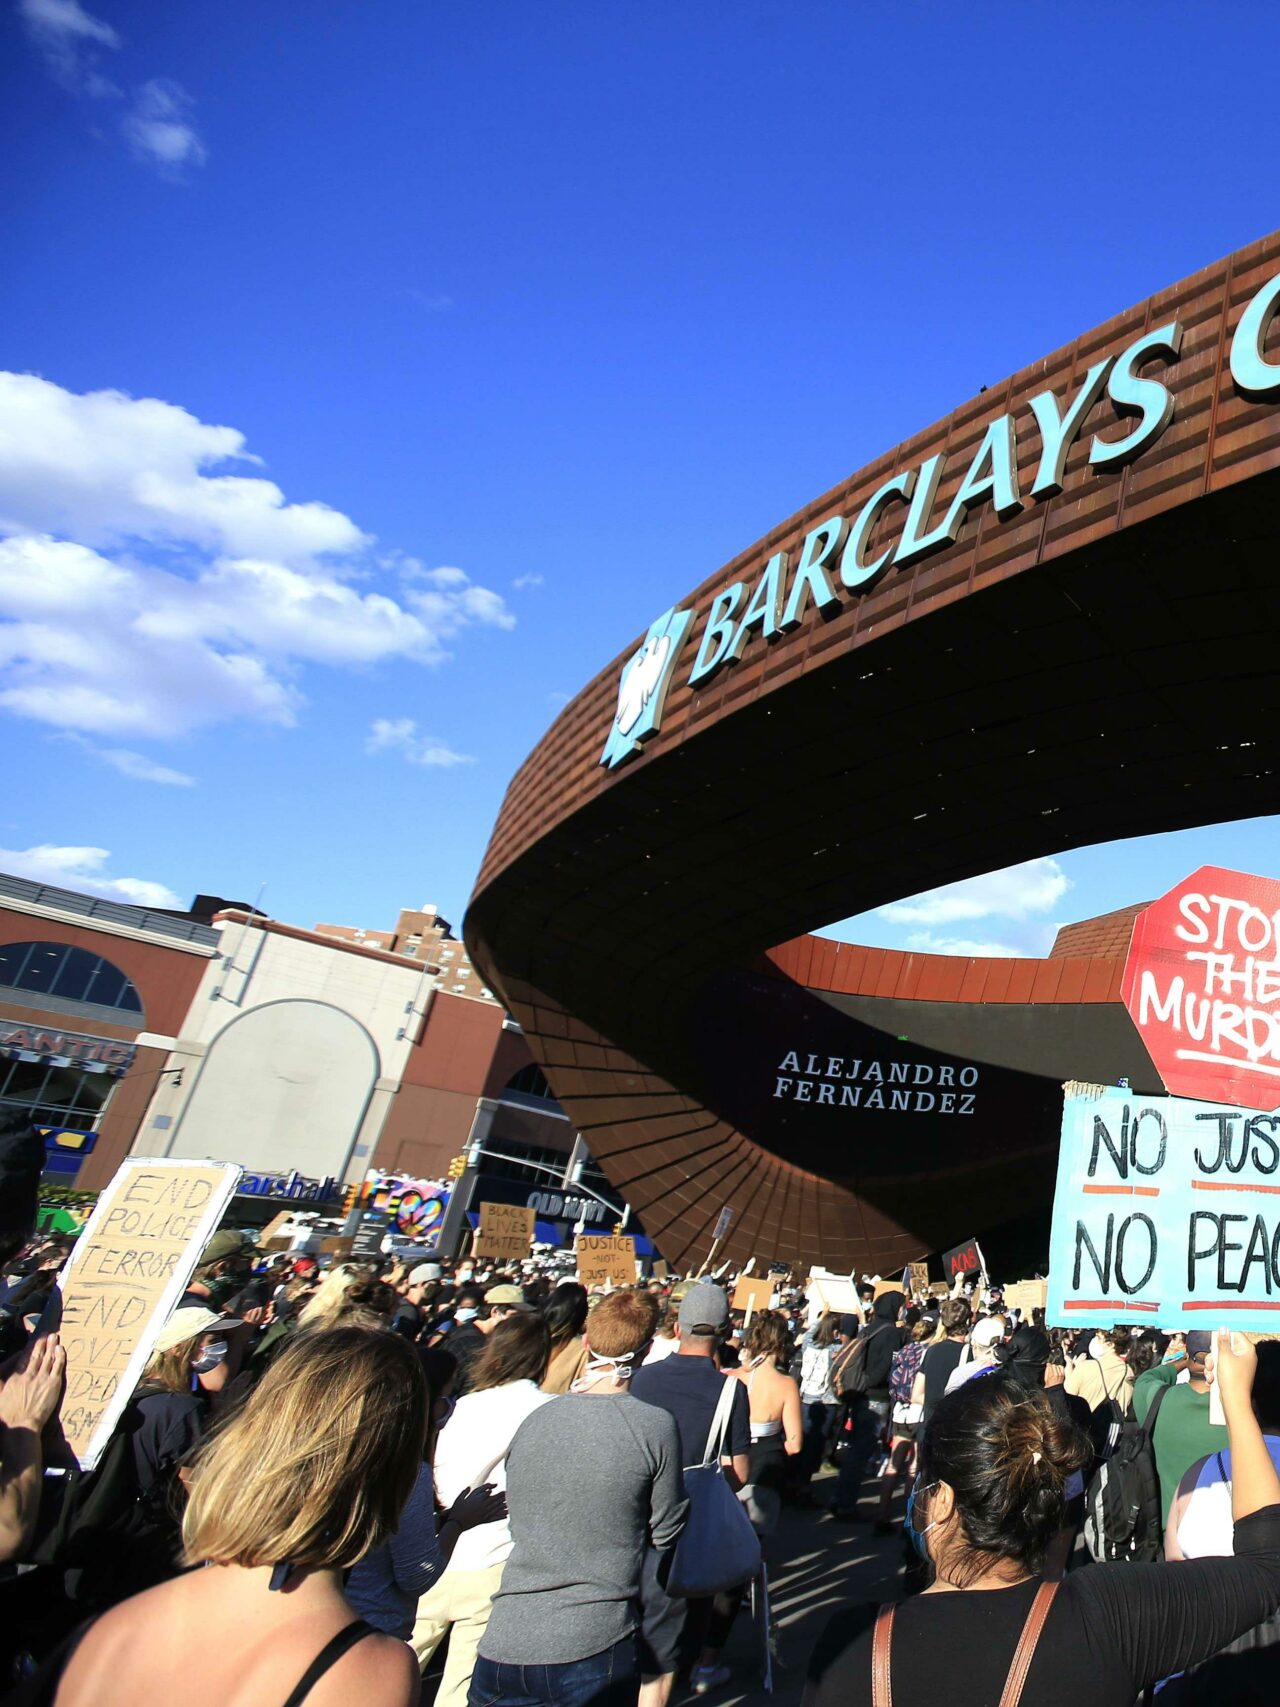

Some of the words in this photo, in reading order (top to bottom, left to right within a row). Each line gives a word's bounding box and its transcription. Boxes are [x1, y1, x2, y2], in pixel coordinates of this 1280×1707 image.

[689, 321, 1183, 688] BARCLAYS
[777, 1051, 979, 1087] ALEJANDRO
[773, 1076, 976, 1115] FERNÁNDEZ
[1087, 1104, 1168, 1179] NO
[123, 1174, 213, 1209] END
[240, 1169, 339, 1200] arshall
[100, 1207, 203, 1241] POLICE
[488, 1206, 528, 1222] BLACK
[526, 1191, 563, 1217] OLD
[562, 1195, 608, 1223] NAVY
[483, 1235, 530, 1250] MATTER
[487, 1219, 527, 1234] LIVES
[578, 1236, 632, 1252] JUSTICE
[1072, 1213, 1157, 1294] NO
[78, 1245, 182, 1280] TERROR
[62, 1295, 147, 1329] END
